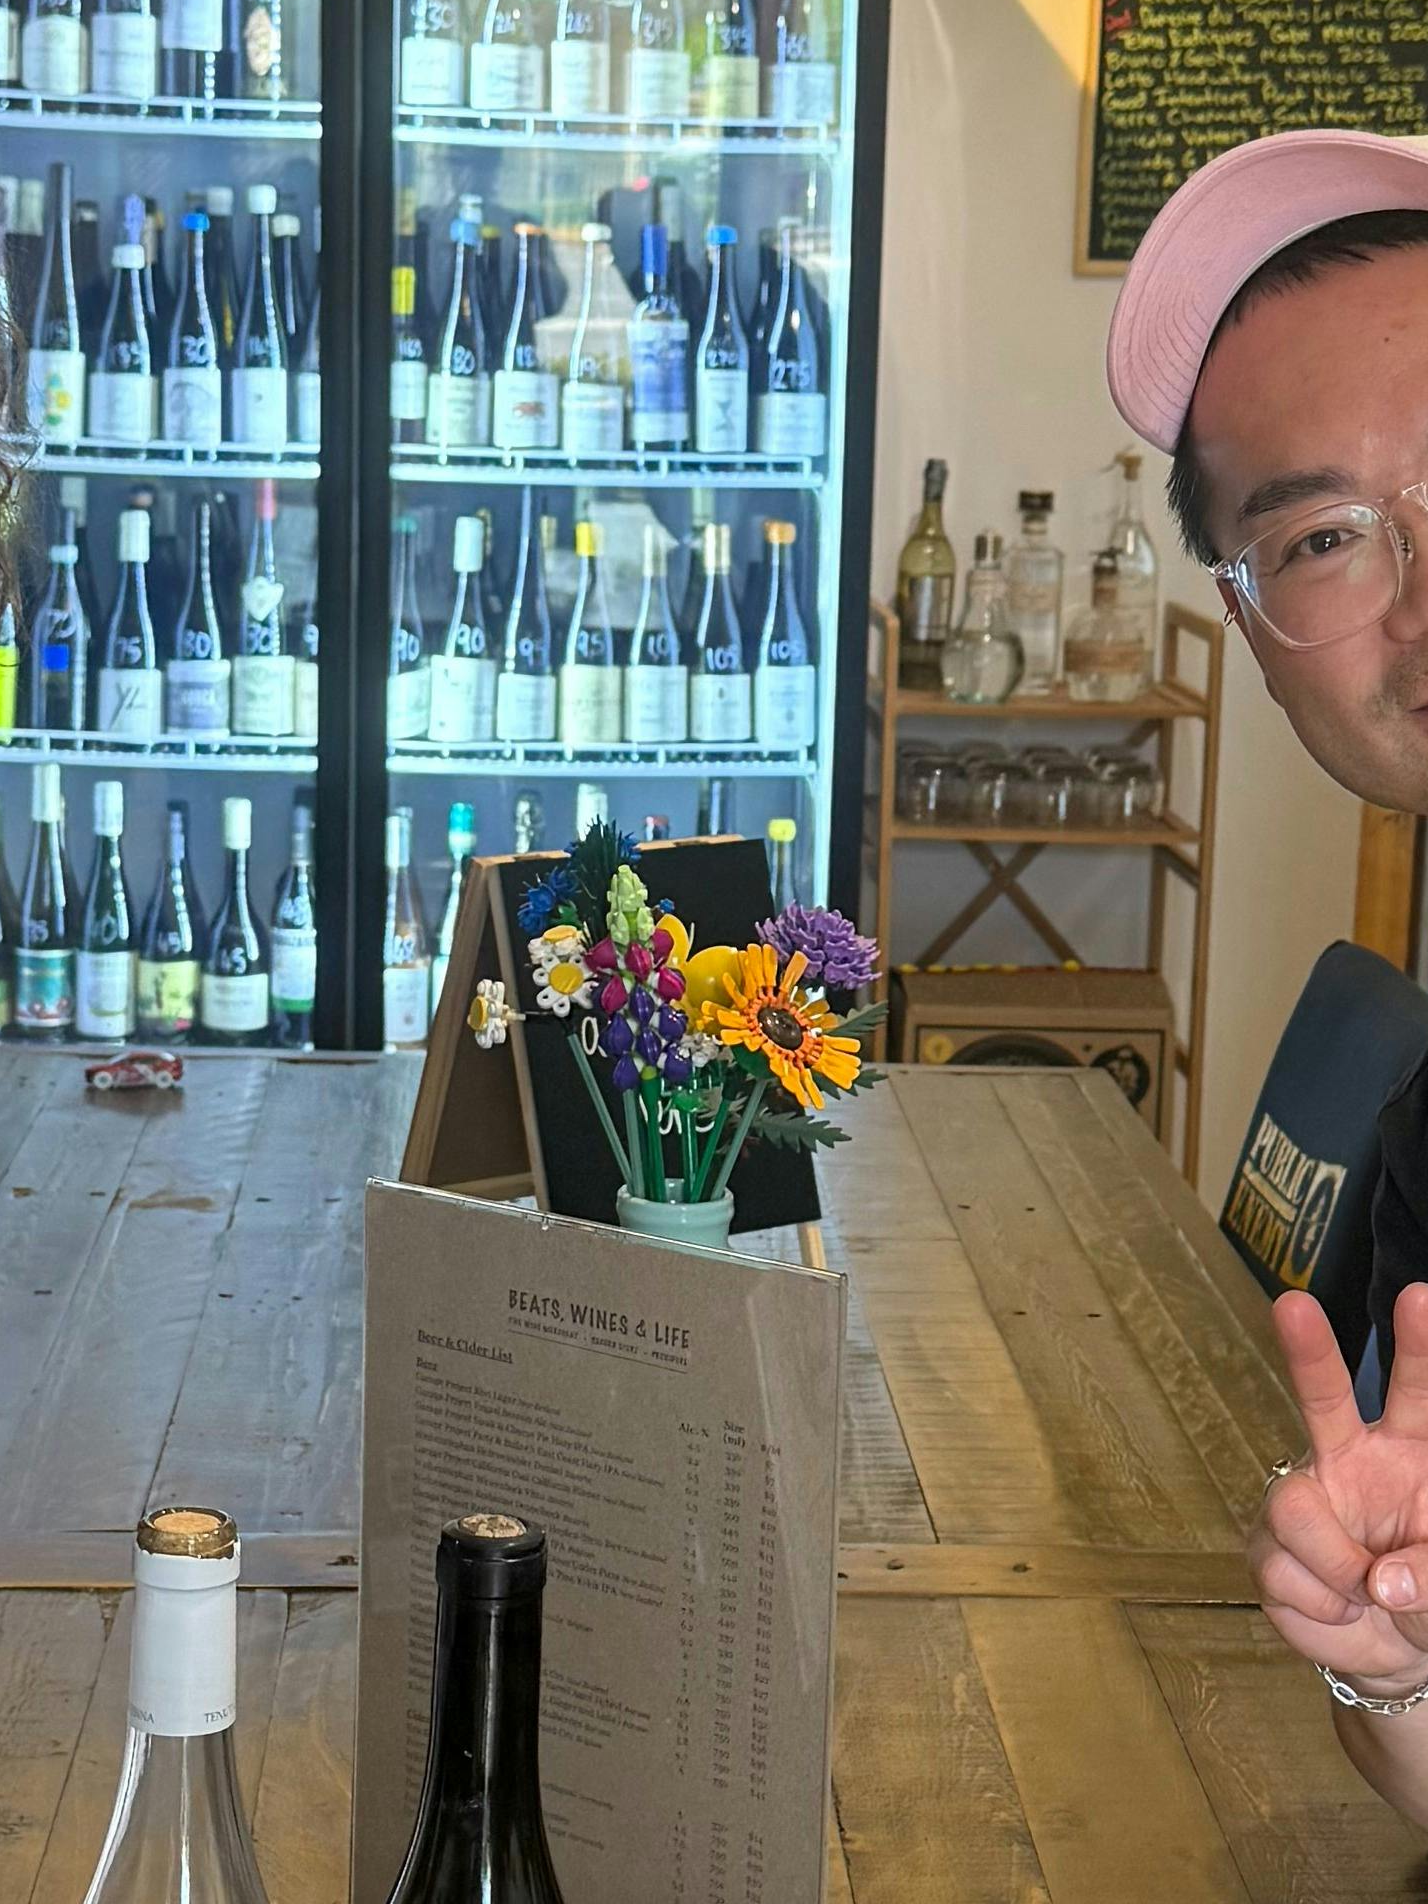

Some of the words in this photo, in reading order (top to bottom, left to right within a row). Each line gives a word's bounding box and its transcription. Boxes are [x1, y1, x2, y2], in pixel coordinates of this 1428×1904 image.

[456, 622, 486, 656] 90
[1250, 1112, 1316, 1206] PUBLIC
[1226, 1175, 1291, 1274] ENEMY
[508, 1288, 564, 1323] BEATS,
[570, 1302, 629, 1336] WINES
[635, 1319, 647, 1338] &
[654, 1321, 691, 1349] LIFE
[456, 1338, 490, 1359] Cider
[491, 1347, 514, 1365] List
